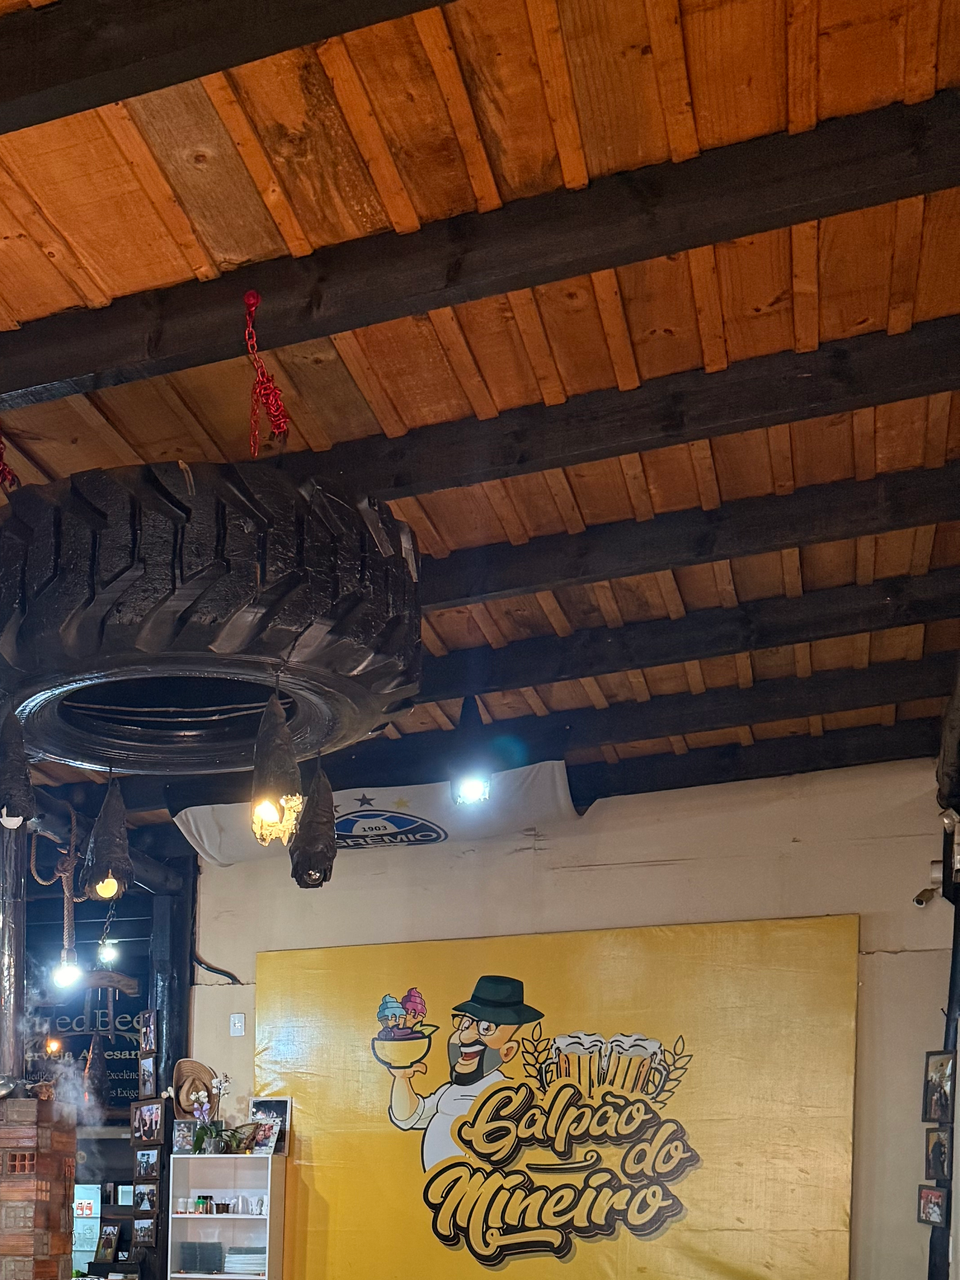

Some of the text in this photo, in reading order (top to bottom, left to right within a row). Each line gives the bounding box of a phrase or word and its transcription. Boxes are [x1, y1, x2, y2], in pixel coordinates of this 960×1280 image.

[361, 825, 388, 833] 1903
[25, 1050, 73, 1062] erveja
[459, 1083, 655, 1164] Galpão
[622, 1121, 693, 1177] do
[426, 1166, 674, 1258] Mineiro
